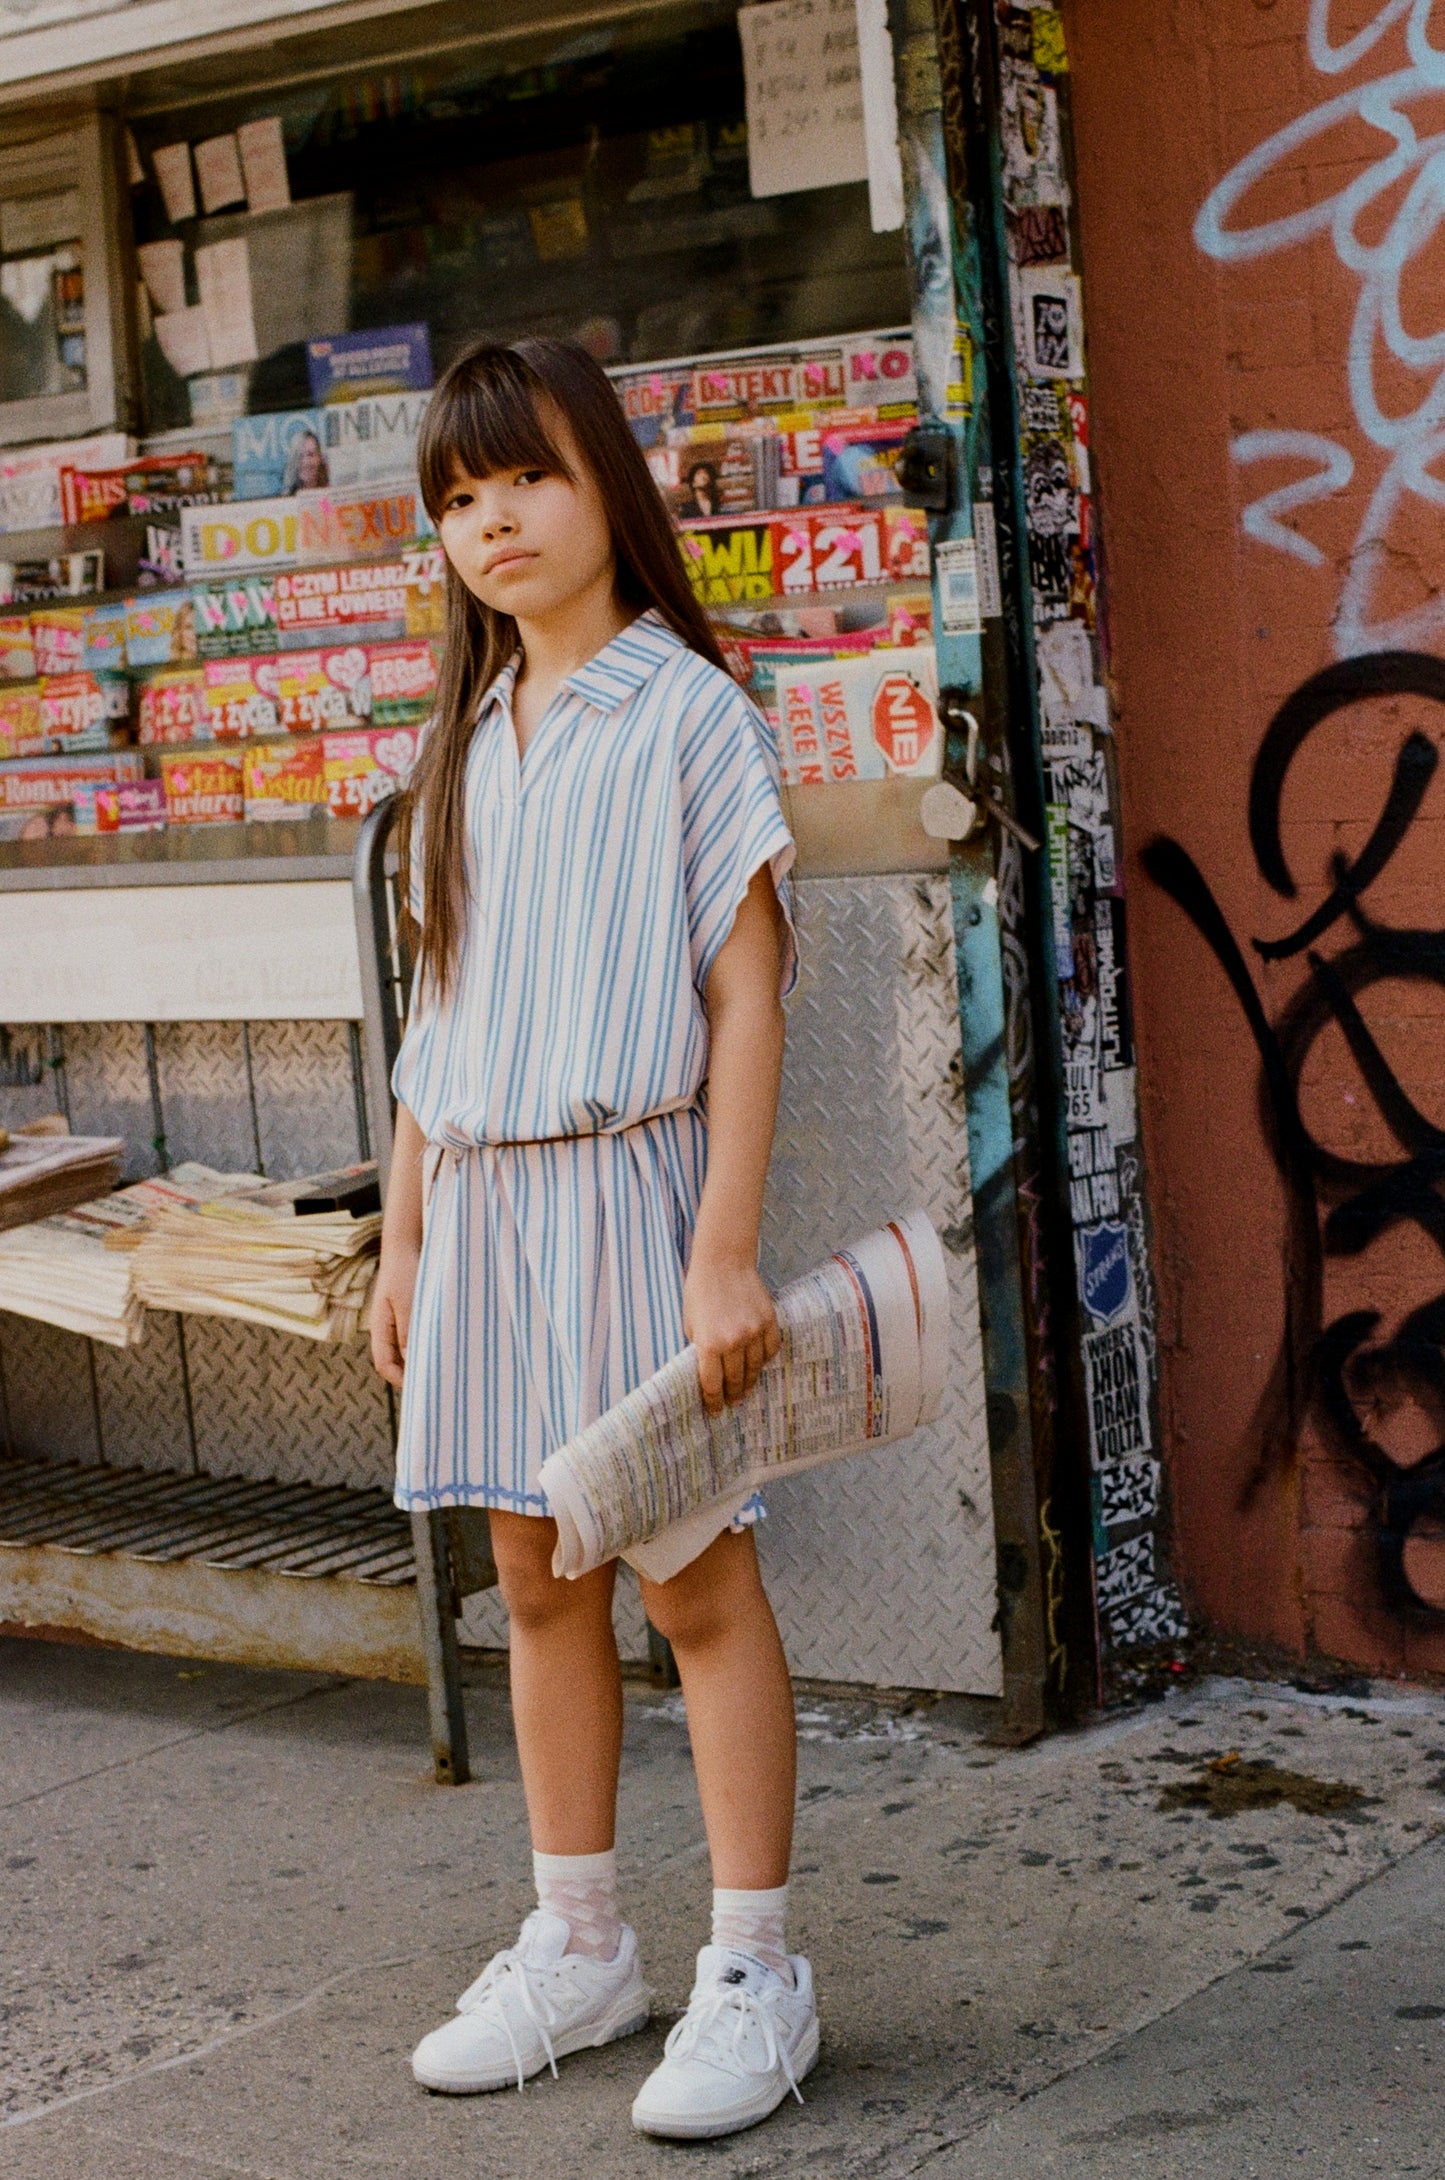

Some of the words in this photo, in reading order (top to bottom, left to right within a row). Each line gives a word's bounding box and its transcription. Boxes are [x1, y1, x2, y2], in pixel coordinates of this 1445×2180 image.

[819, 680, 858, 780] WSZYS
[884, 684, 919, 768] NIE
[1091, 1346, 1139, 1397] JHON
[1093, 1383, 1140, 1432] DRAW
[1096, 1416, 1145, 1462] VOLTA
